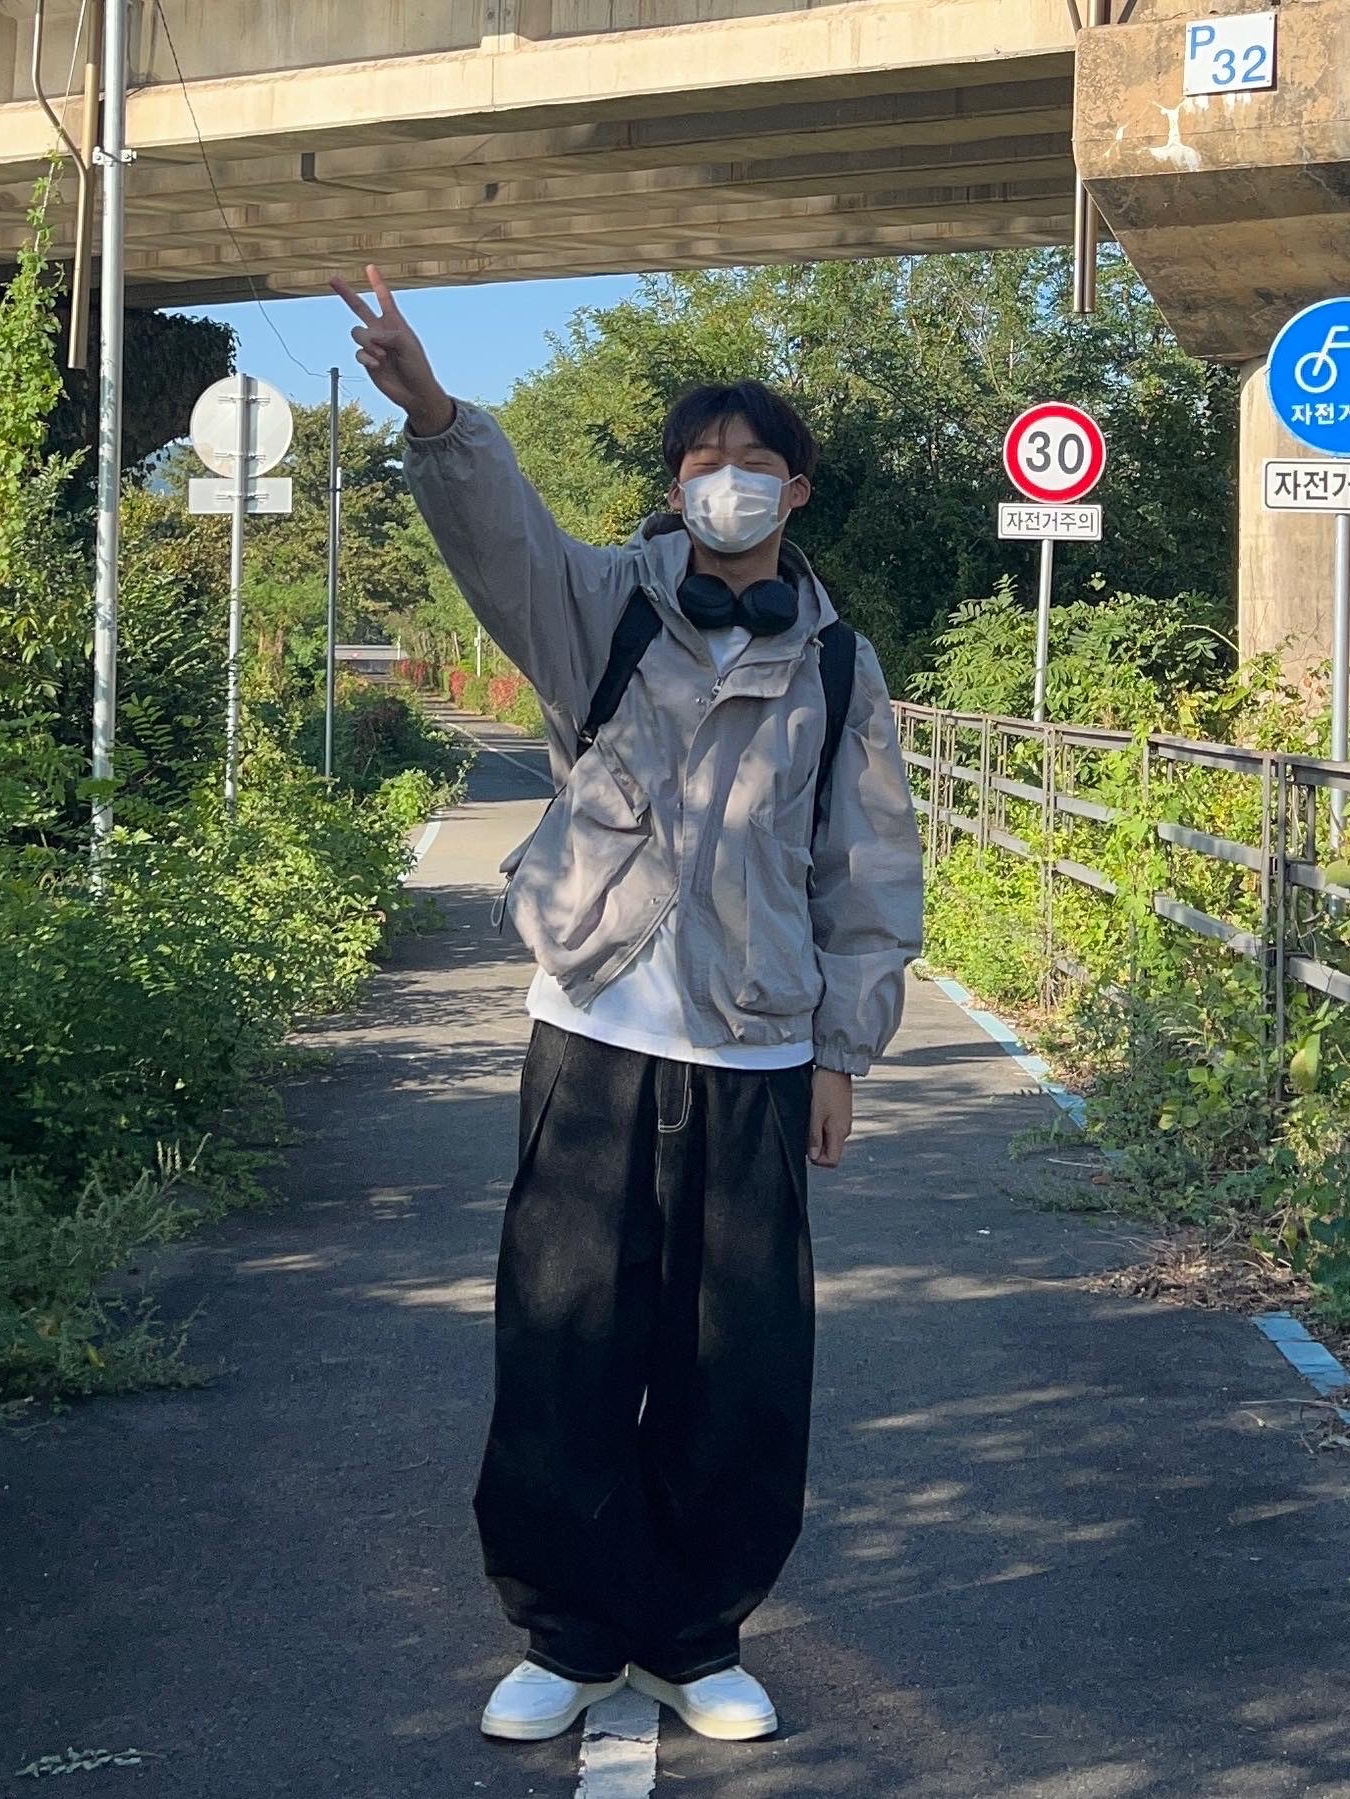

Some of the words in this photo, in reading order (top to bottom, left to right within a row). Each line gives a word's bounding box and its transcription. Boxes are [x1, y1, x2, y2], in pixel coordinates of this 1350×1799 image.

[1212, 45, 1267, 85] 32
[1026, 431, 1085, 475] 30
[1006, 511, 1094, 533] 자전거주의
